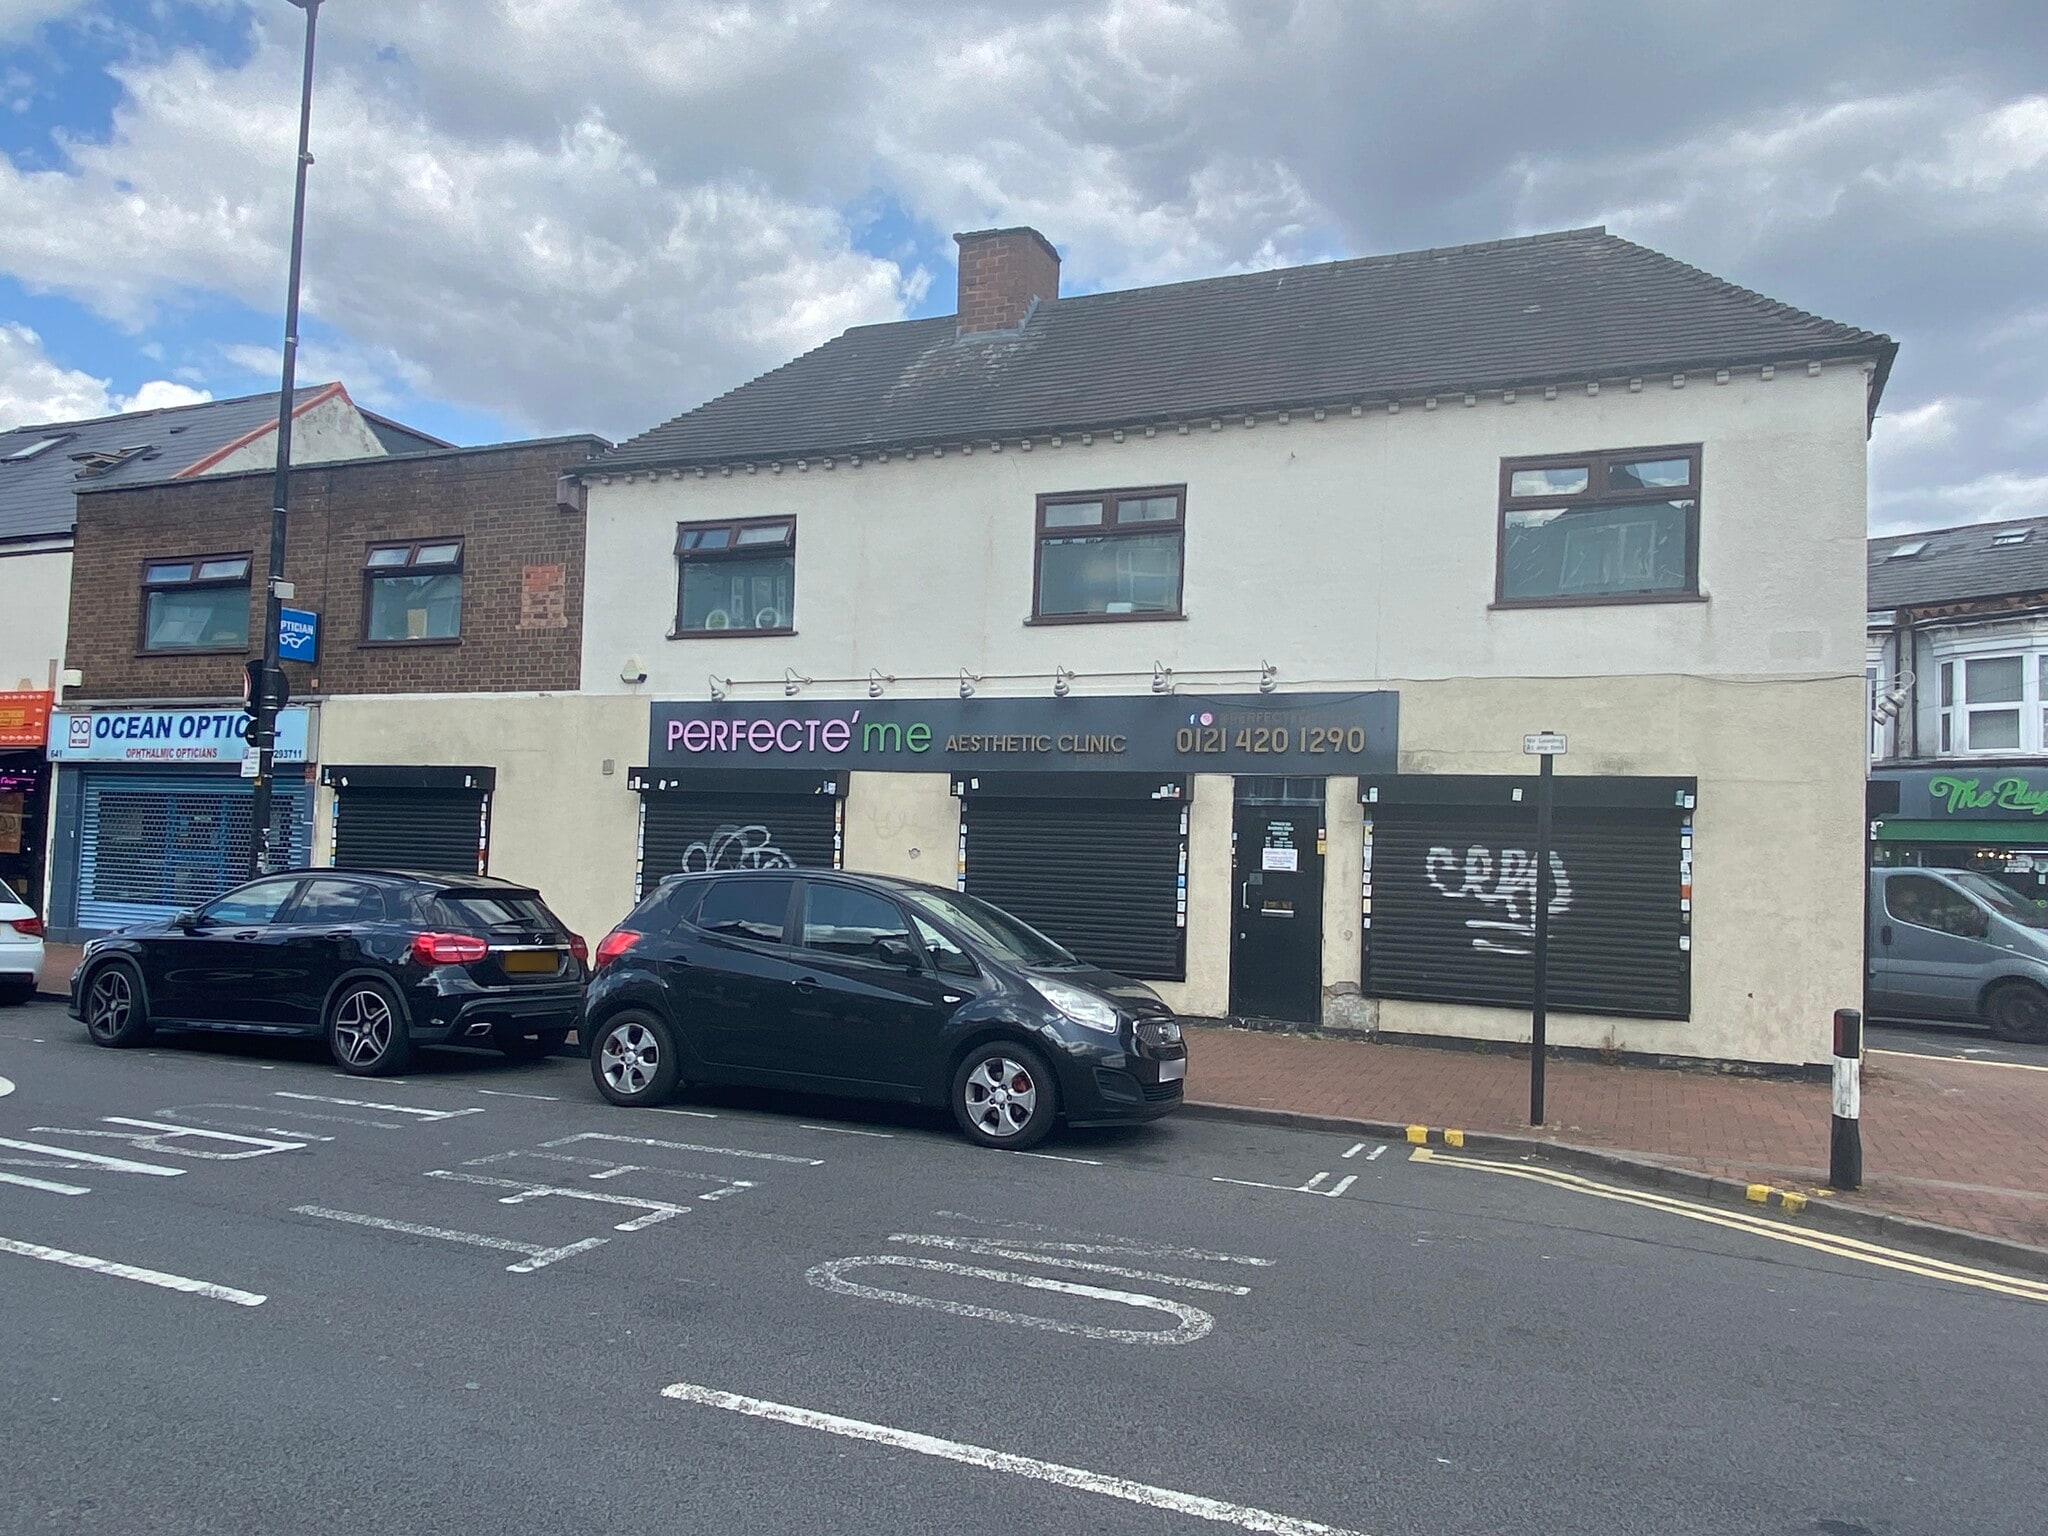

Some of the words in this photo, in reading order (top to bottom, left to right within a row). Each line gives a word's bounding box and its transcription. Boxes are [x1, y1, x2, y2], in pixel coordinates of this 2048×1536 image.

[280, 620, 314, 635] PTICIAN
[95, 716, 173, 739] OCEAN
[179, 714, 281, 739] OPTIC
[945, 734, 1051, 753] AESTHETIC
[1058, 734, 1127, 753] CLINIC
[1176, 727, 1227, 753] 0121
[1235, 727, 1289, 753] 420
[1300, 726, 1366, 753] 1290
[50, 750, 63, 758] 641
[126, 748, 174, 758] OPHTHALMIC
[176, 748, 218, 758] OPTICIANS
[1928, 776, 1996, 814] The
